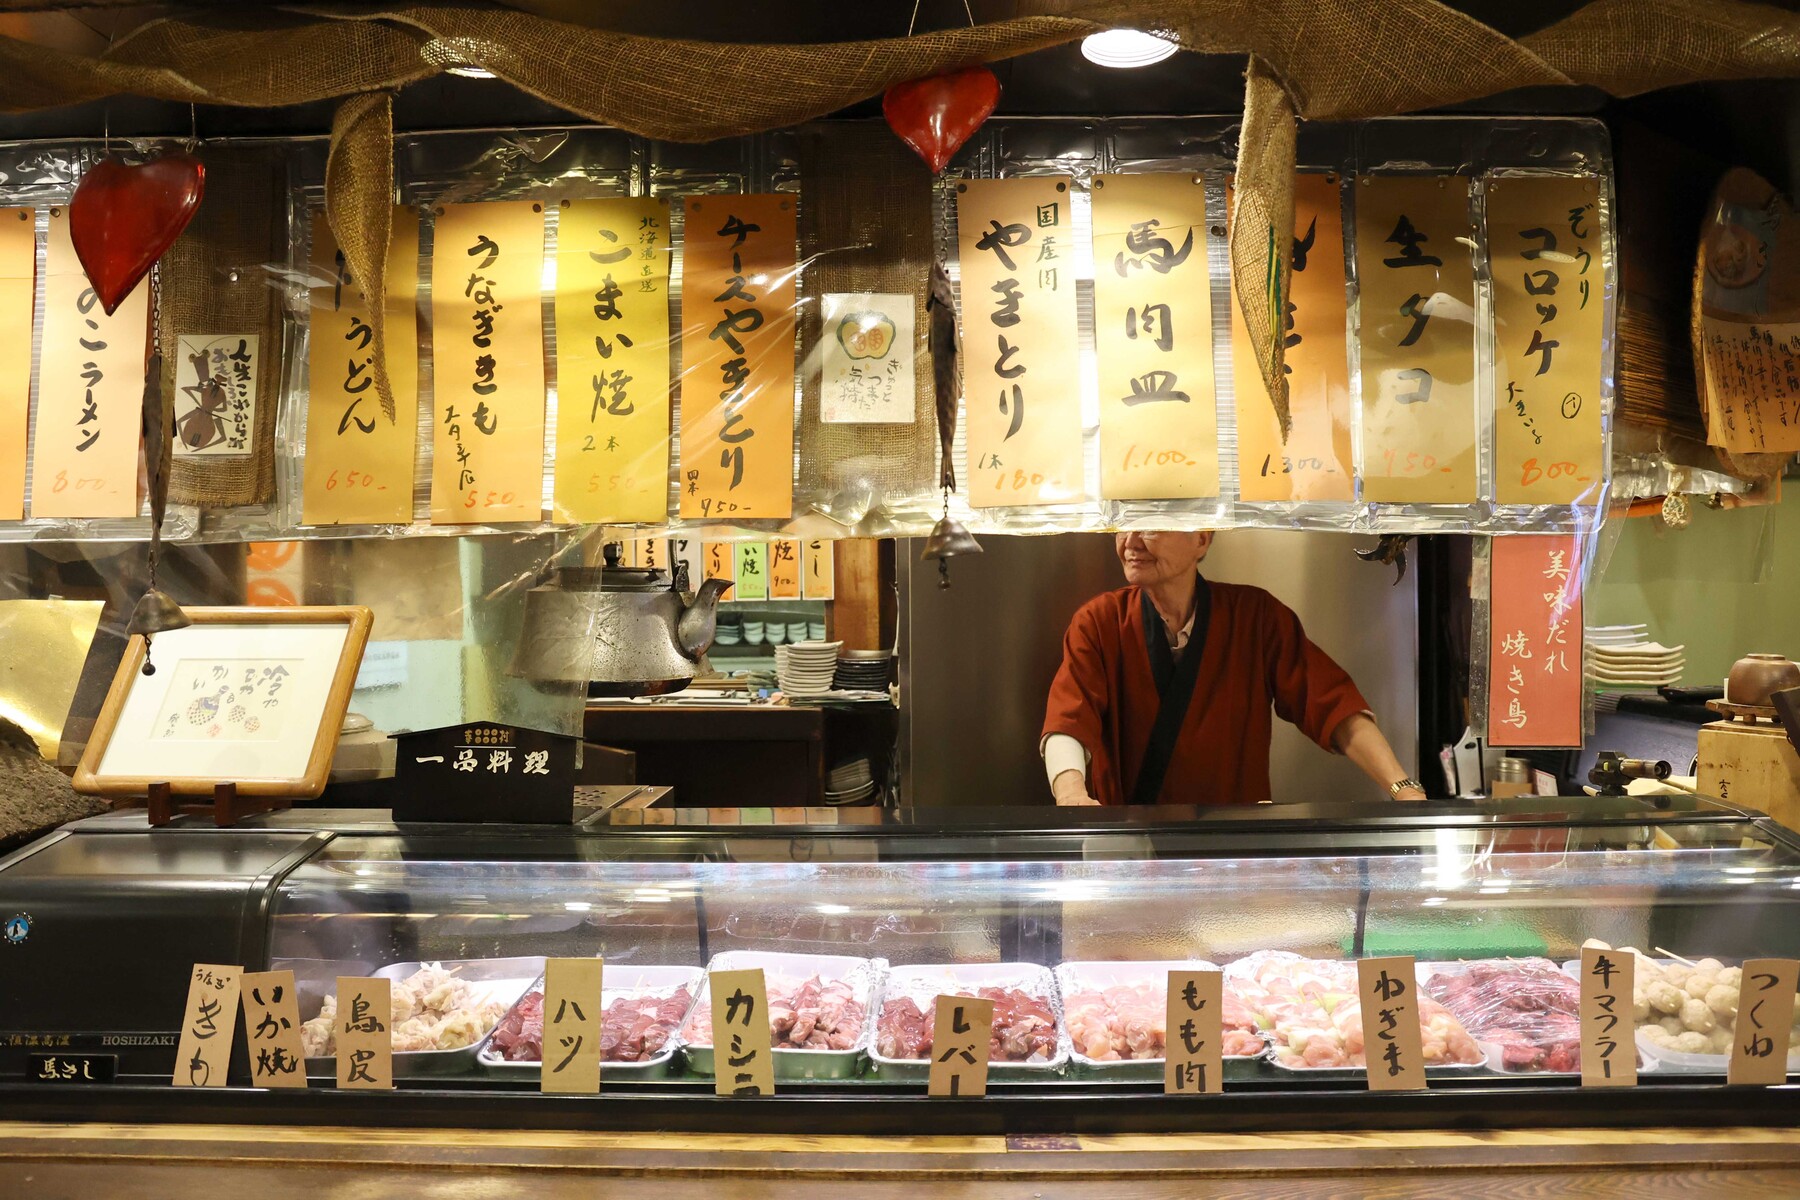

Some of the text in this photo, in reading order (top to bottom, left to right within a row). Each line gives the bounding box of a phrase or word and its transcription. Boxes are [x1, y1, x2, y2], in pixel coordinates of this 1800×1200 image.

[639, 216, 659, 293] 北海道直送
[1036, 202, 1058, 291] 国産肉
[335, 249, 376, 436] うどん
[465, 235, 503, 436] うなぎきも
[589, 229, 634, 423] こまい焼
[708, 214, 765, 491] チーズやきとり
[975, 219, 1032, 442] やきとり
[1114, 218, 1193, 408] 馬肉皿
[1383, 215, 1443, 404] 生タコ
[1518, 227, 1560, 377] コロッケ
[76, 269, 108, 453] のこラーメン
[1542, 549, 1573, 675] 美味だれ
[1501, 629, 1533, 729] 焼き鳥
[415, 748, 550, 775] 一品料理
[195, 969, 231, 990] うなぎ
[252, 985, 299, 1077] いか焼
[1592, 955, 1621, 1078] 牛マフラー
[39, 1057, 96, 1080] 馬さし
[102, 1035, 176, 1046] HOSHIZAKI
[190, 998, 222, 1087] きも
[345, 993, 385, 1083] 鳥皮
[552, 999, 586, 1073] ハツ
[938, 1006, 977, 1096] レバー
[1175, 980, 1207, 1093] もも肉
